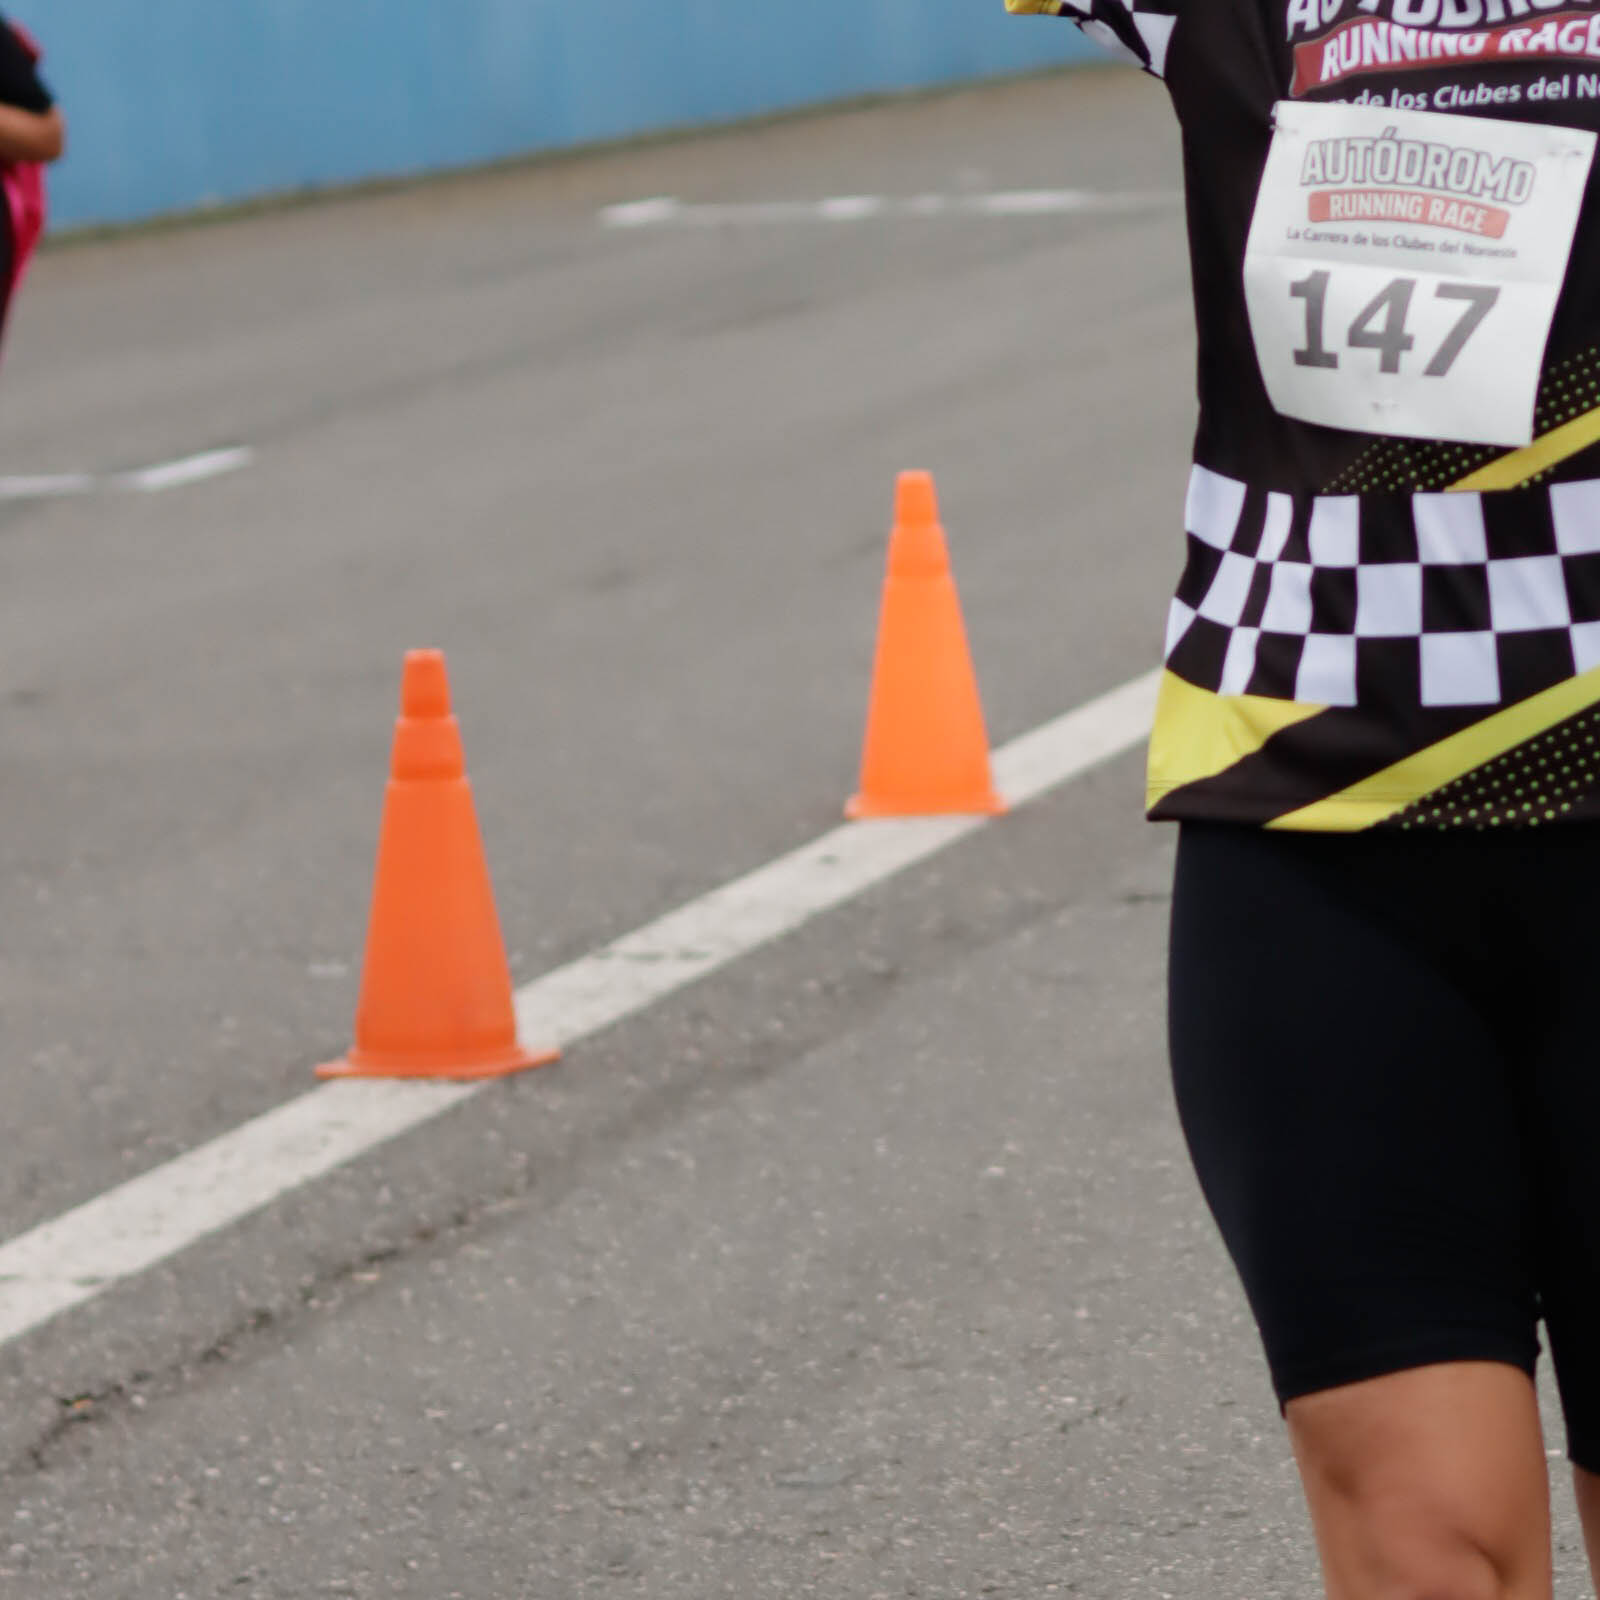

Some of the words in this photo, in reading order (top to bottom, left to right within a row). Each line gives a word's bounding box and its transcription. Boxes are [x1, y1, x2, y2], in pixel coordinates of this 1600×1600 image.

[1391, 88, 1428, 110] los
[1433, 82, 1522, 109] Clubes
[1527, 73, 1570, 101] del
[1299, 126, 1537, 205] AUTÓDROMO
[1328, 191, 1424, 220] RUNNING
[1428, 198, 1488, 232] RACE
[1286, 226, 1300, 240] La
[1303, 227, 1348, 244] Carrera
[1353, 231, 1368, 246] de
[1372, 232, 1389, 248] los
[1393, 235, 1434, 252] Clubes
[1438, 239, 1459, 254] del
[1289, 269, 1501, 377] 147
